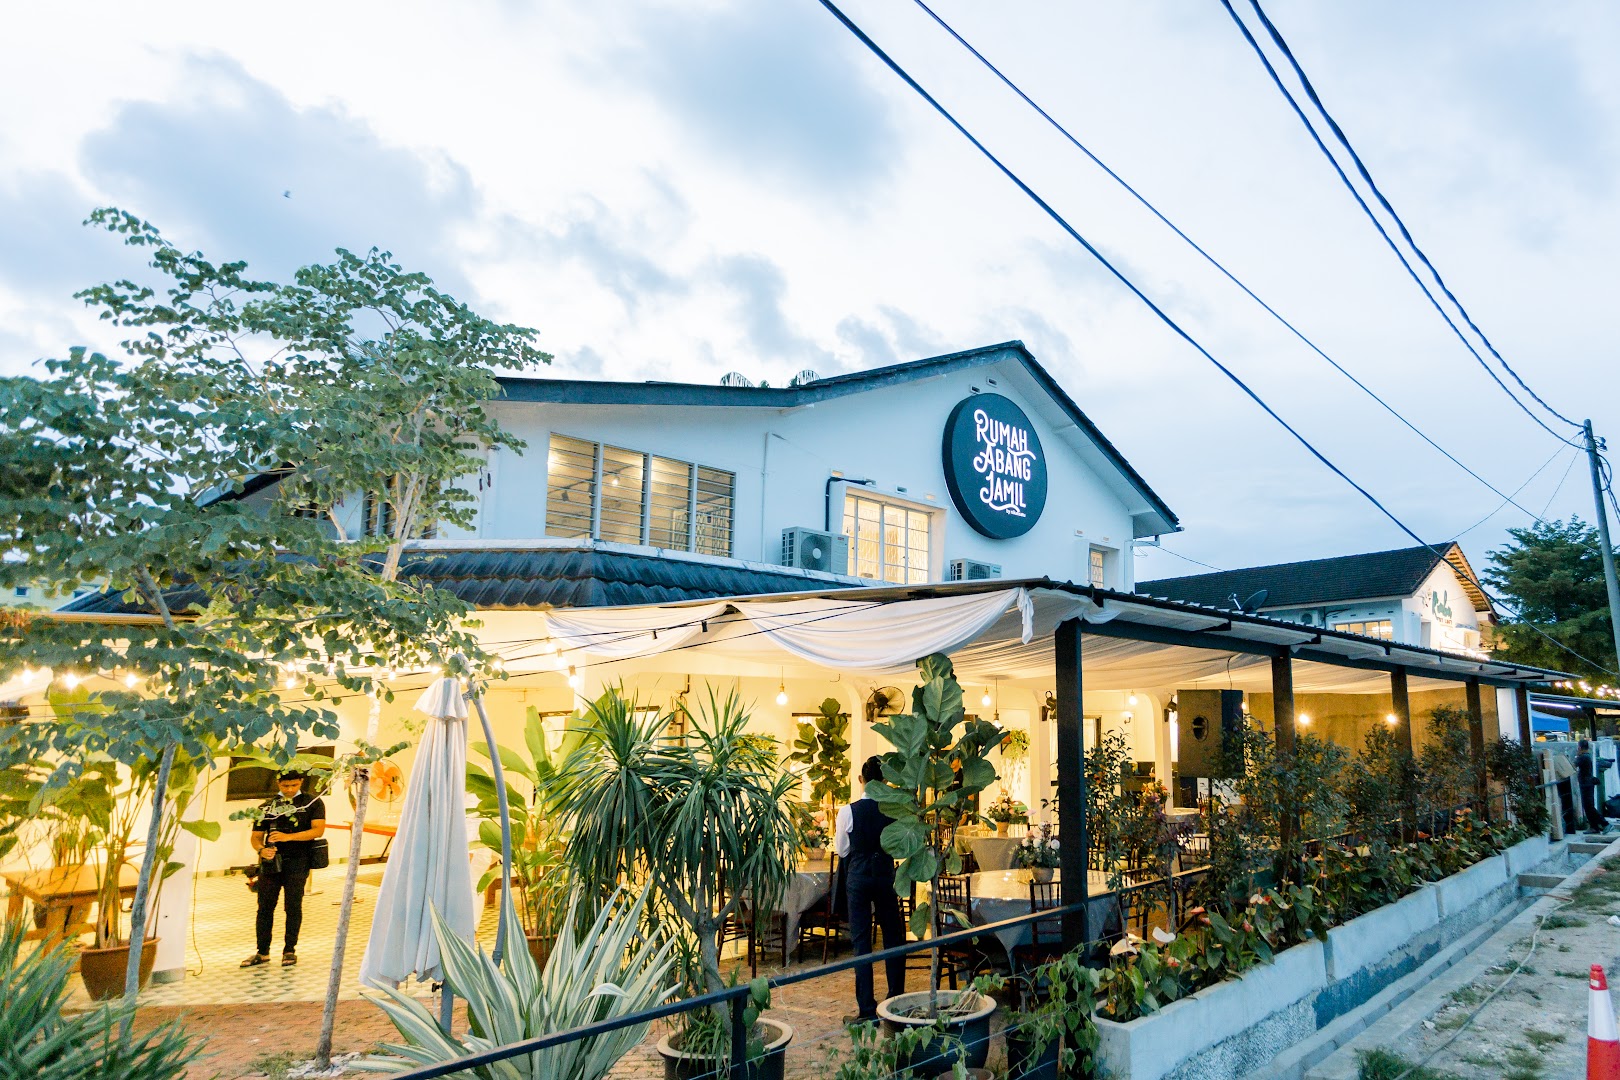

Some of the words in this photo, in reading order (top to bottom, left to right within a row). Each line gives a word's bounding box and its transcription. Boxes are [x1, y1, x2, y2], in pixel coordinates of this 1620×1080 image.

[973, 409, 1036, 460] RUMAH
[973, 443, 1031, 481] ABANG
[979, 470, 1026, 512] JAMIL
